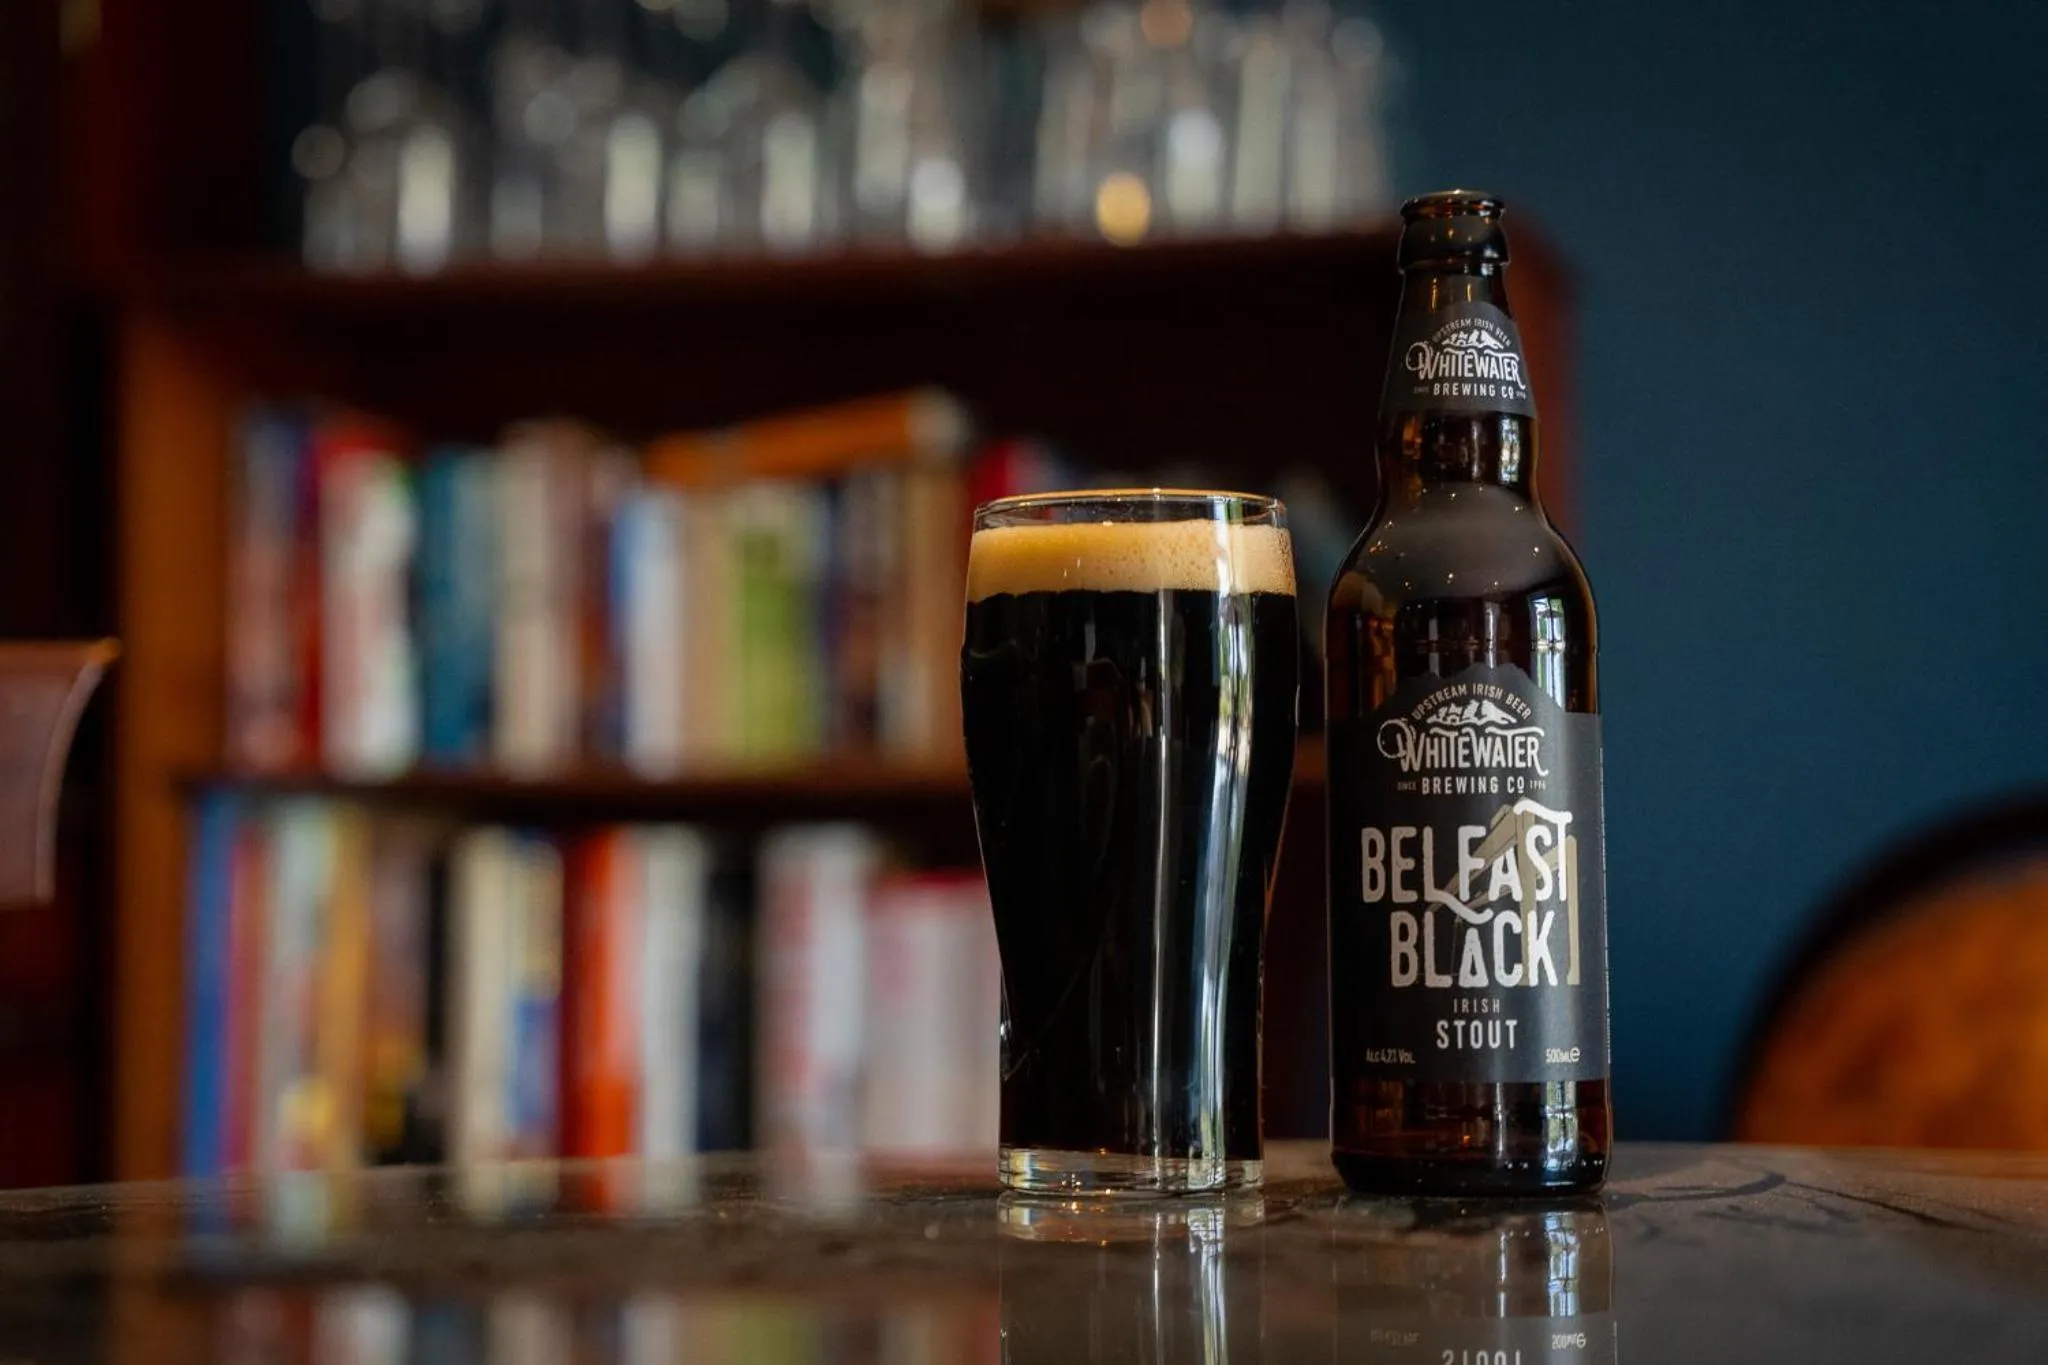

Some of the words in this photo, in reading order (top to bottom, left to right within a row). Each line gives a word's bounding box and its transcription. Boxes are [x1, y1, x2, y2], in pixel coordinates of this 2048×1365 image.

[1433, 382, 1496, 397] BREWING
[1411, 683, 1468, 721] UPSTREAM
[1472, 683, 1504, 700] IRISH
[1505, 693, 1532, 720] BEER
[1421, 775, 1499, 795] BREWING
[1361, 797, 1573, 925] BELFAST
[1390, 909, 1558, 988] BLACK
[1453, 998, 1501, 1013] IRISH
[1436, 1019, 1518, 1050] STOUT
